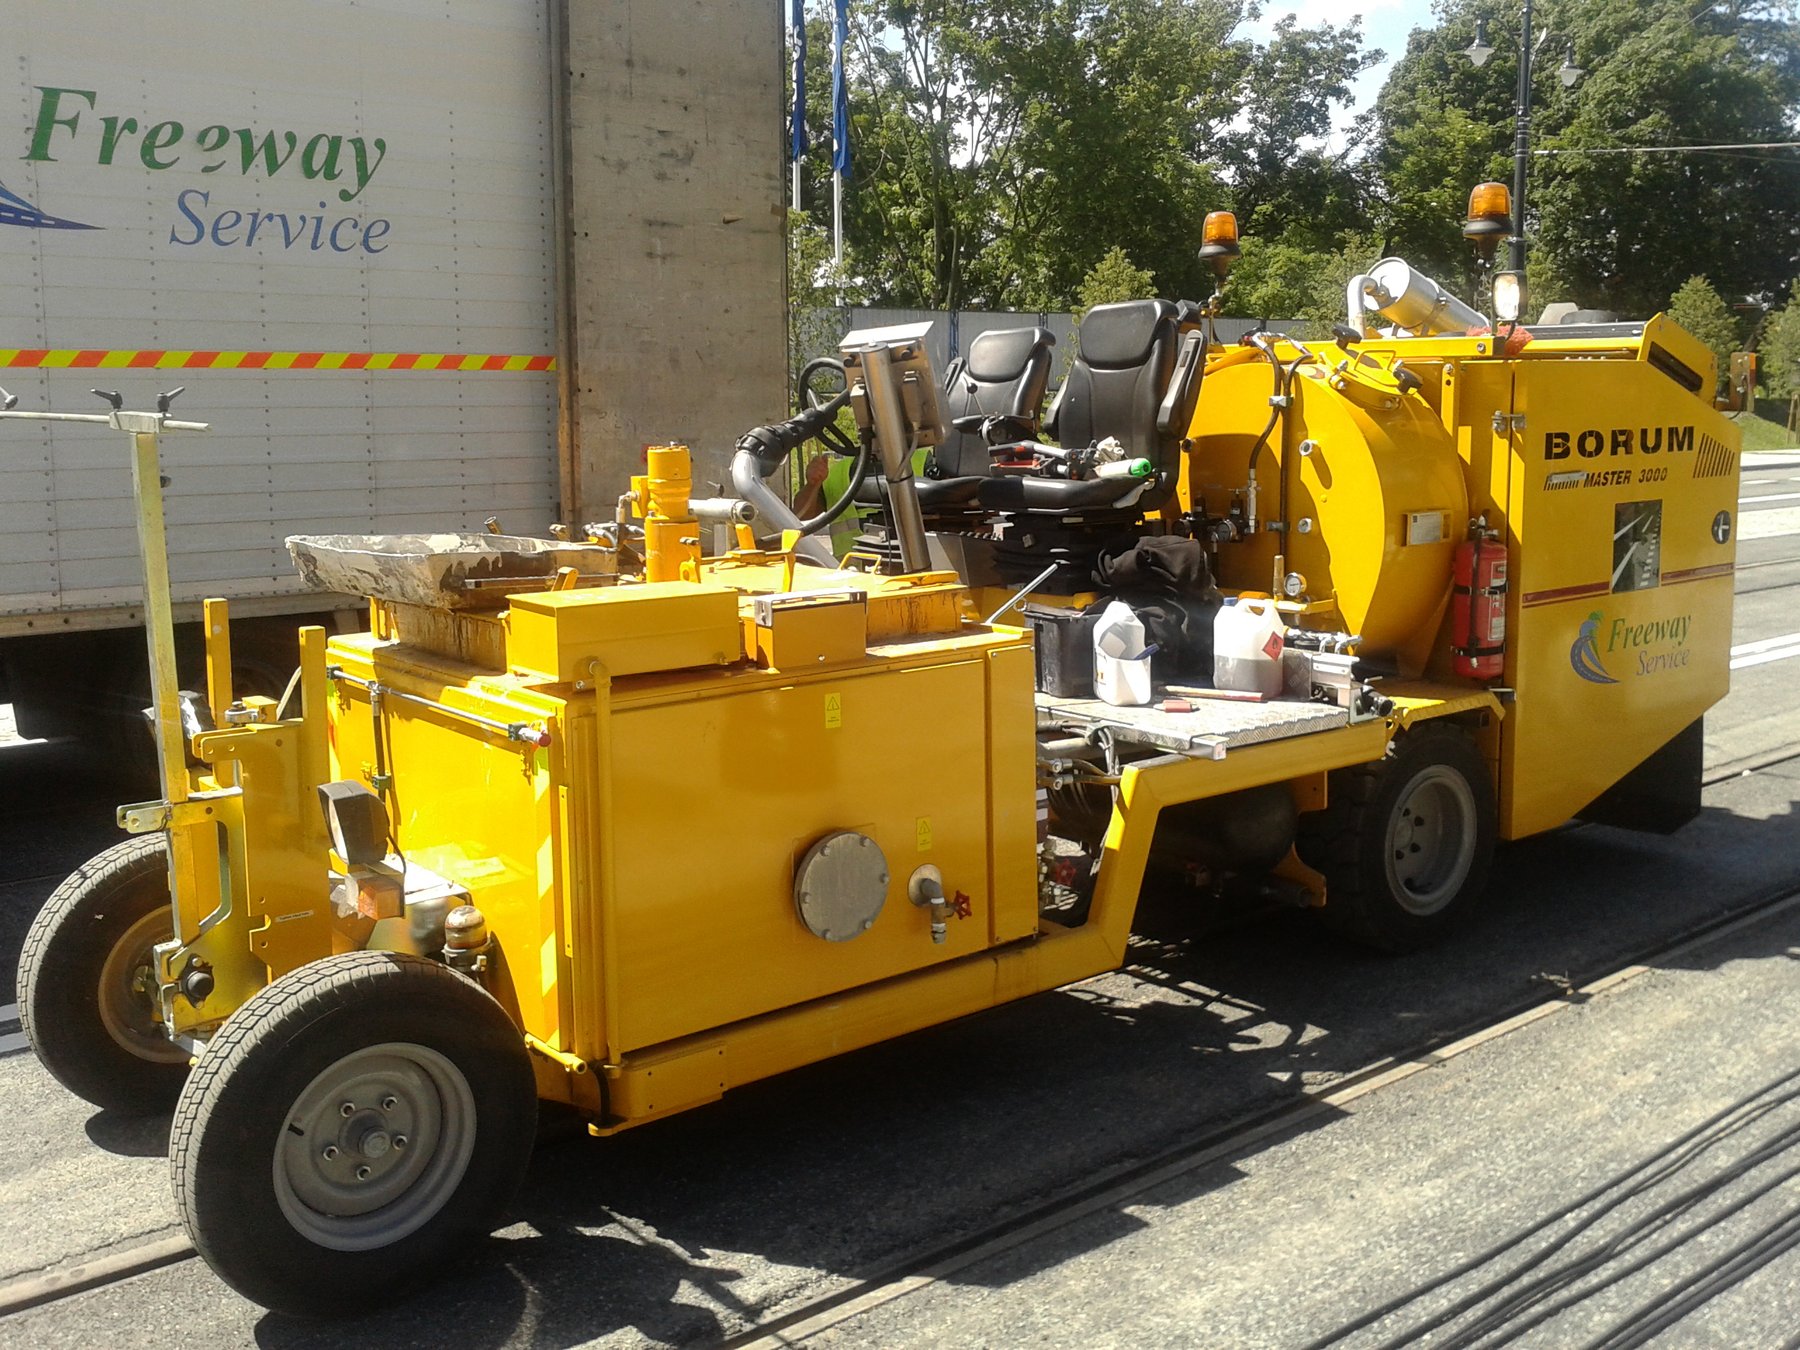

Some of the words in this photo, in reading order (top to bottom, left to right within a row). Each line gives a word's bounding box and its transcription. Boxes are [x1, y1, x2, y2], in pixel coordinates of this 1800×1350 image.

[19, 86, 387, 202] Freeway
[168, 188, 391, 254] Service
[1544, 425, 1695, 460] BORUM
[1583, 469, 1632, 489] MASTER
[1638, 466, 1668, 484] 3000
[1607, 614, 1691, 653] Freeway
[1636, 648, 1690, 676] Service
